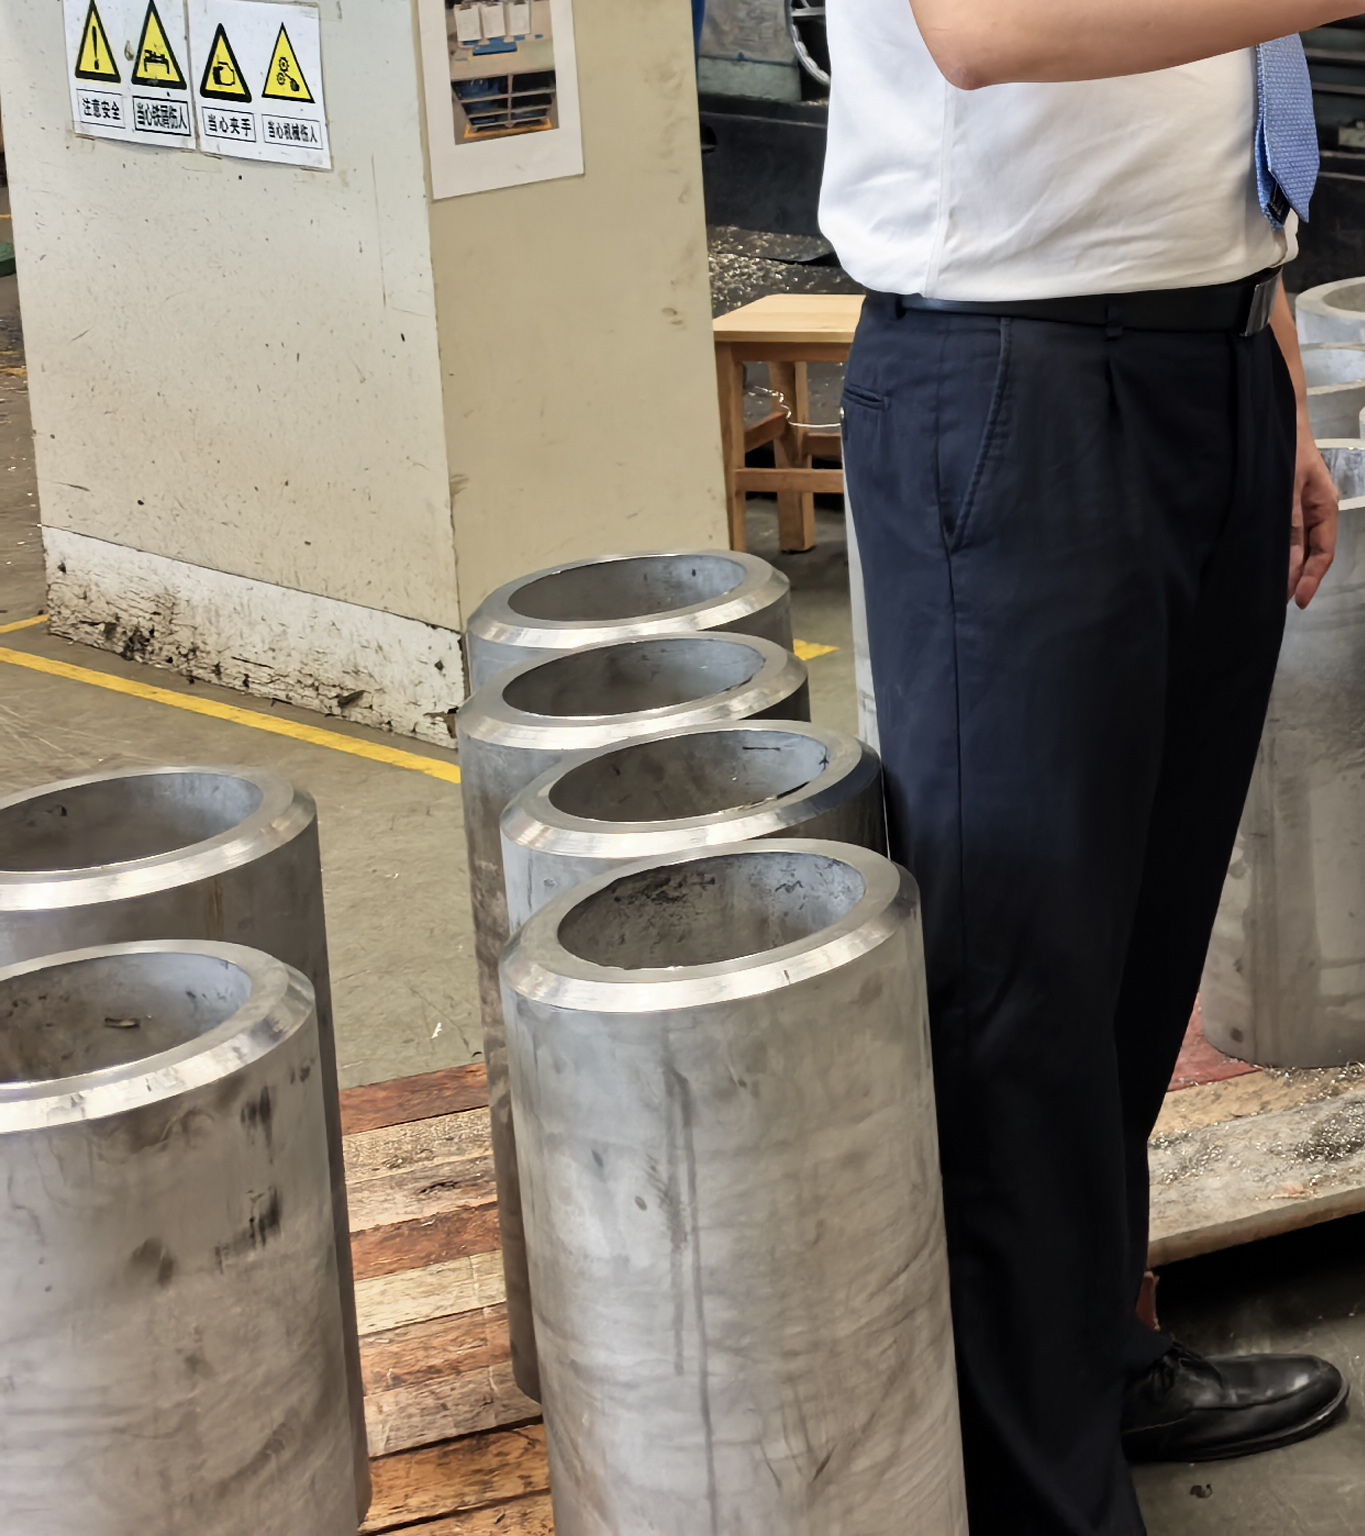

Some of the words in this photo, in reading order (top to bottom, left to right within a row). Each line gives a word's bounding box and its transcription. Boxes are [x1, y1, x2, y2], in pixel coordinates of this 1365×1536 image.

[207, 113, 252, 138] 当心夹手
[267, 121, 318, 144] 当心机械伤人
